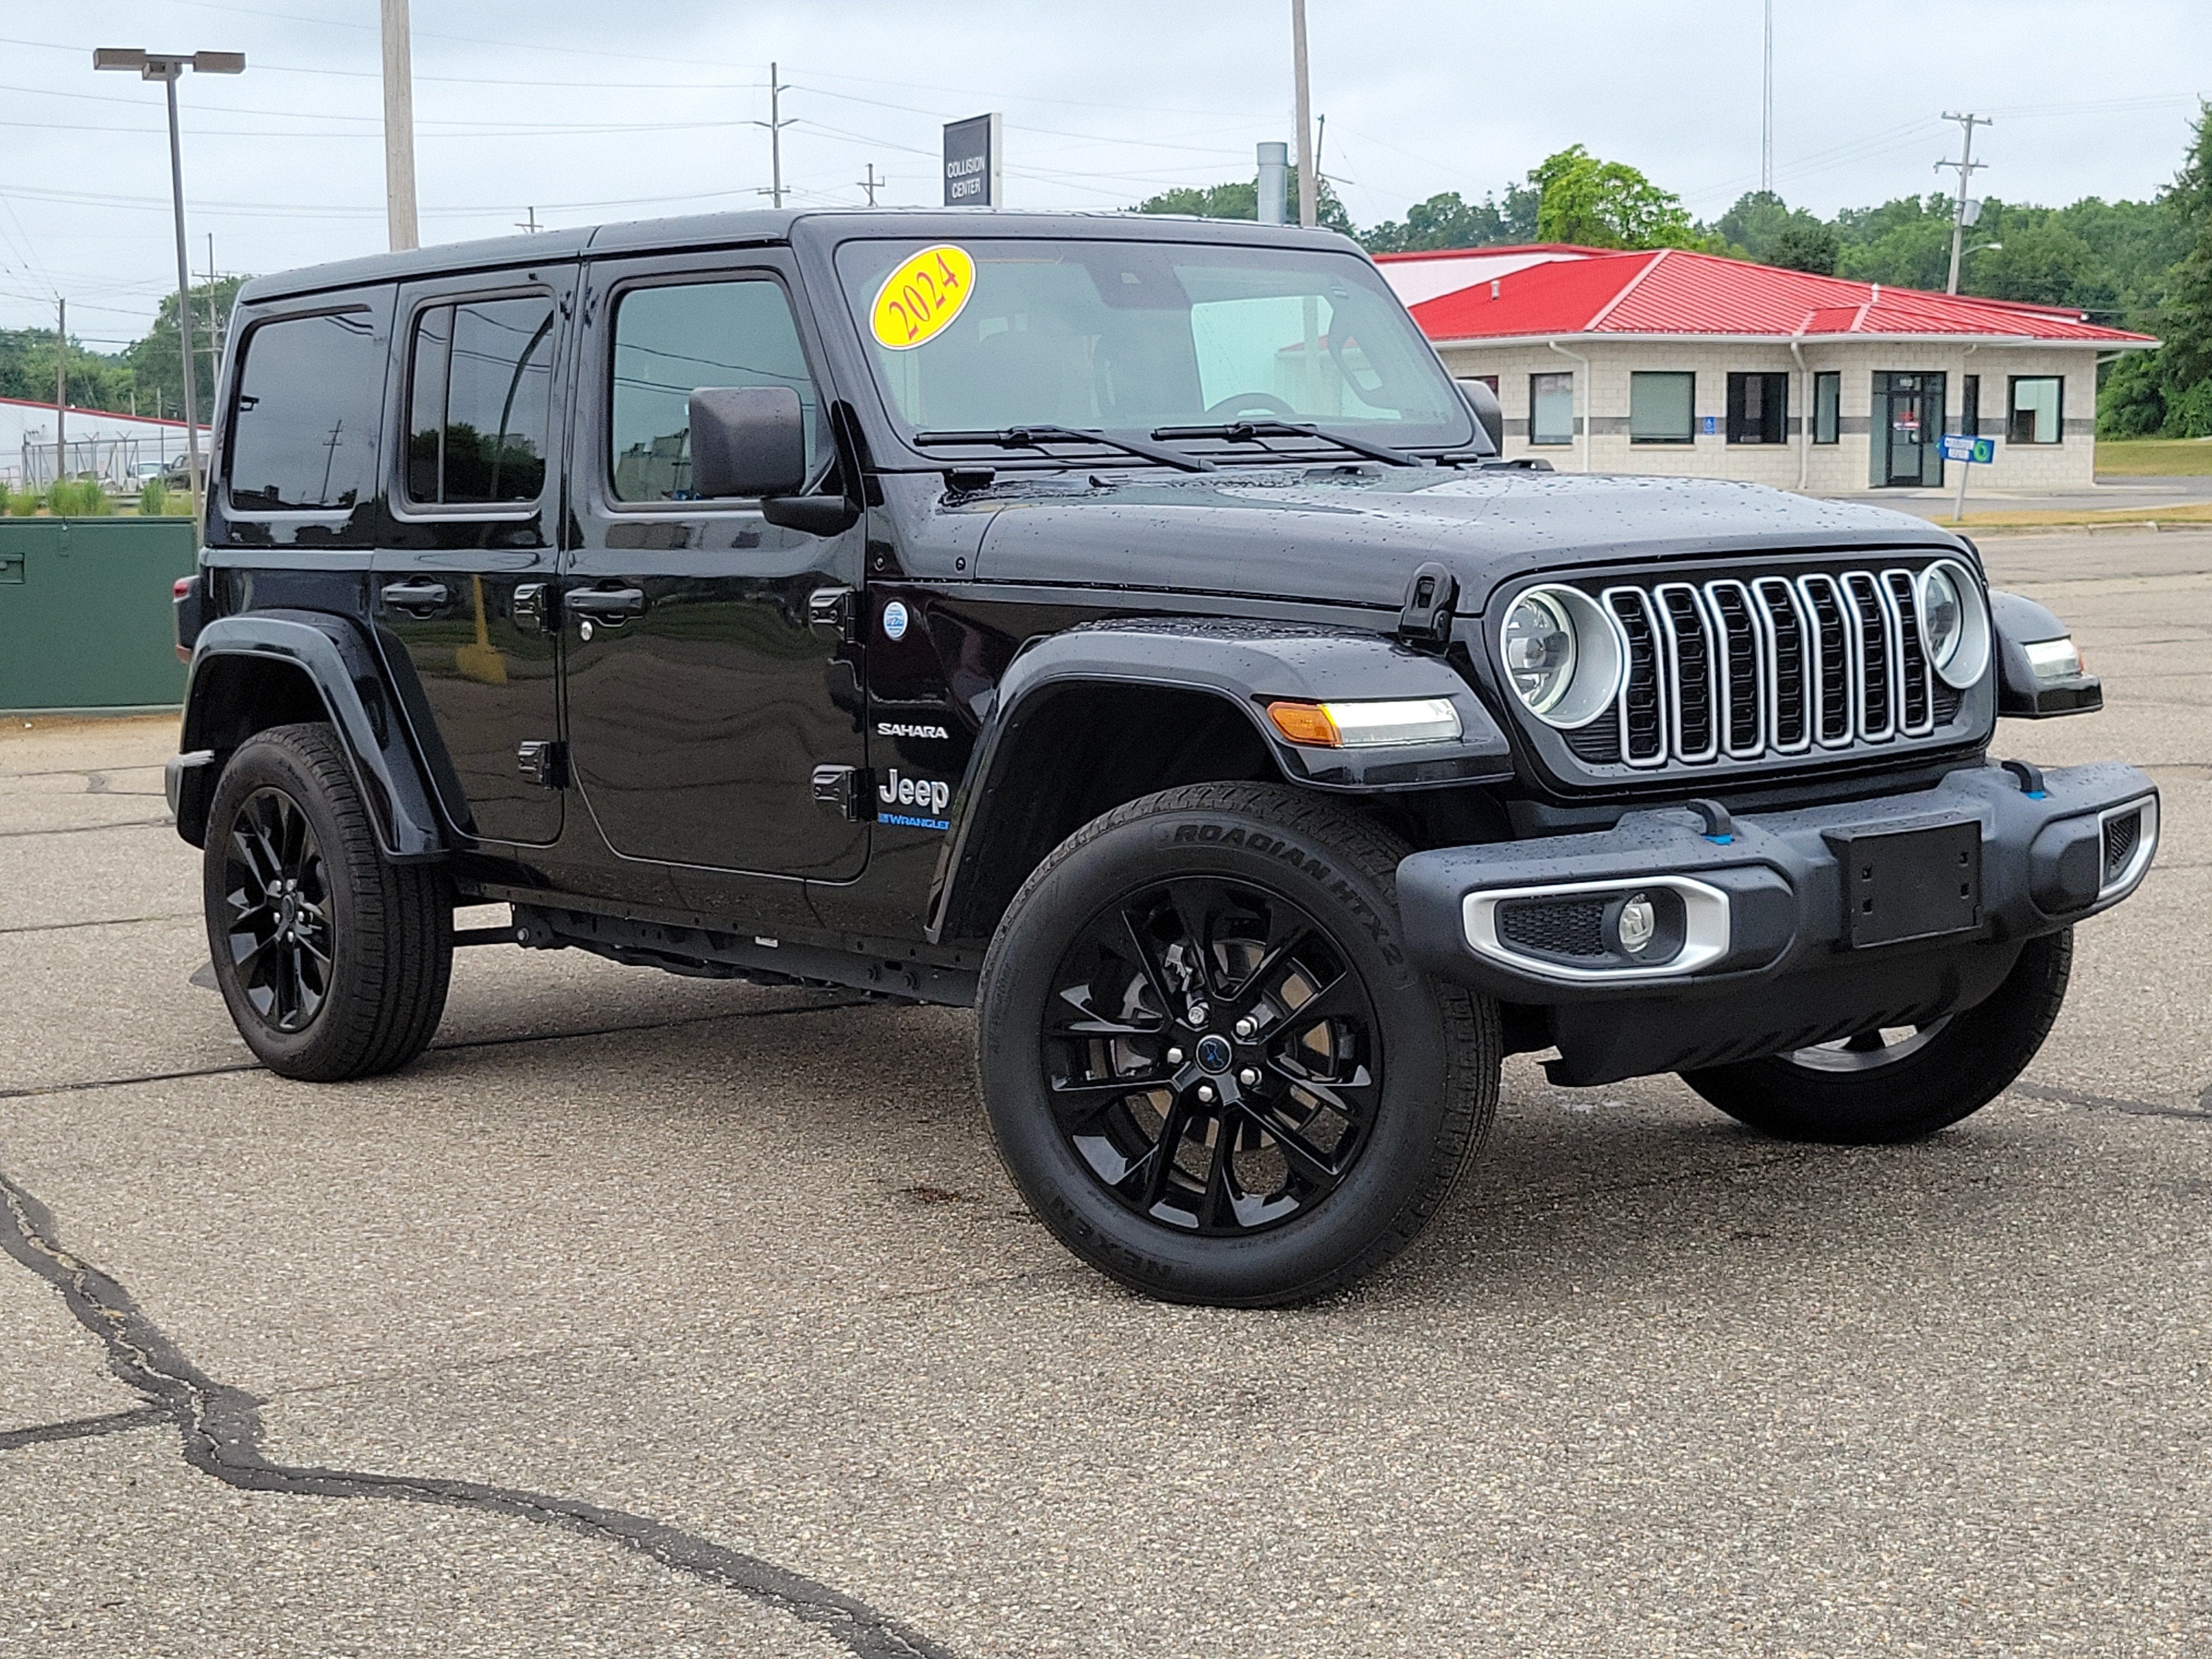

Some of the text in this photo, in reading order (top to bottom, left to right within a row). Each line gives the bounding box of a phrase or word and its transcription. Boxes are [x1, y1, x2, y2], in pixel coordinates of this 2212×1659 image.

[947, 156, 985, 178] COLLISION
[952, 177, 981, 199] CENTER
[889, 252, 959, 340] 2024
[878, 723, 949, 739] SAHARA
[879, 769, 950, 815] Jeep
[1173, 824, 1331, 881] ROADIAN
